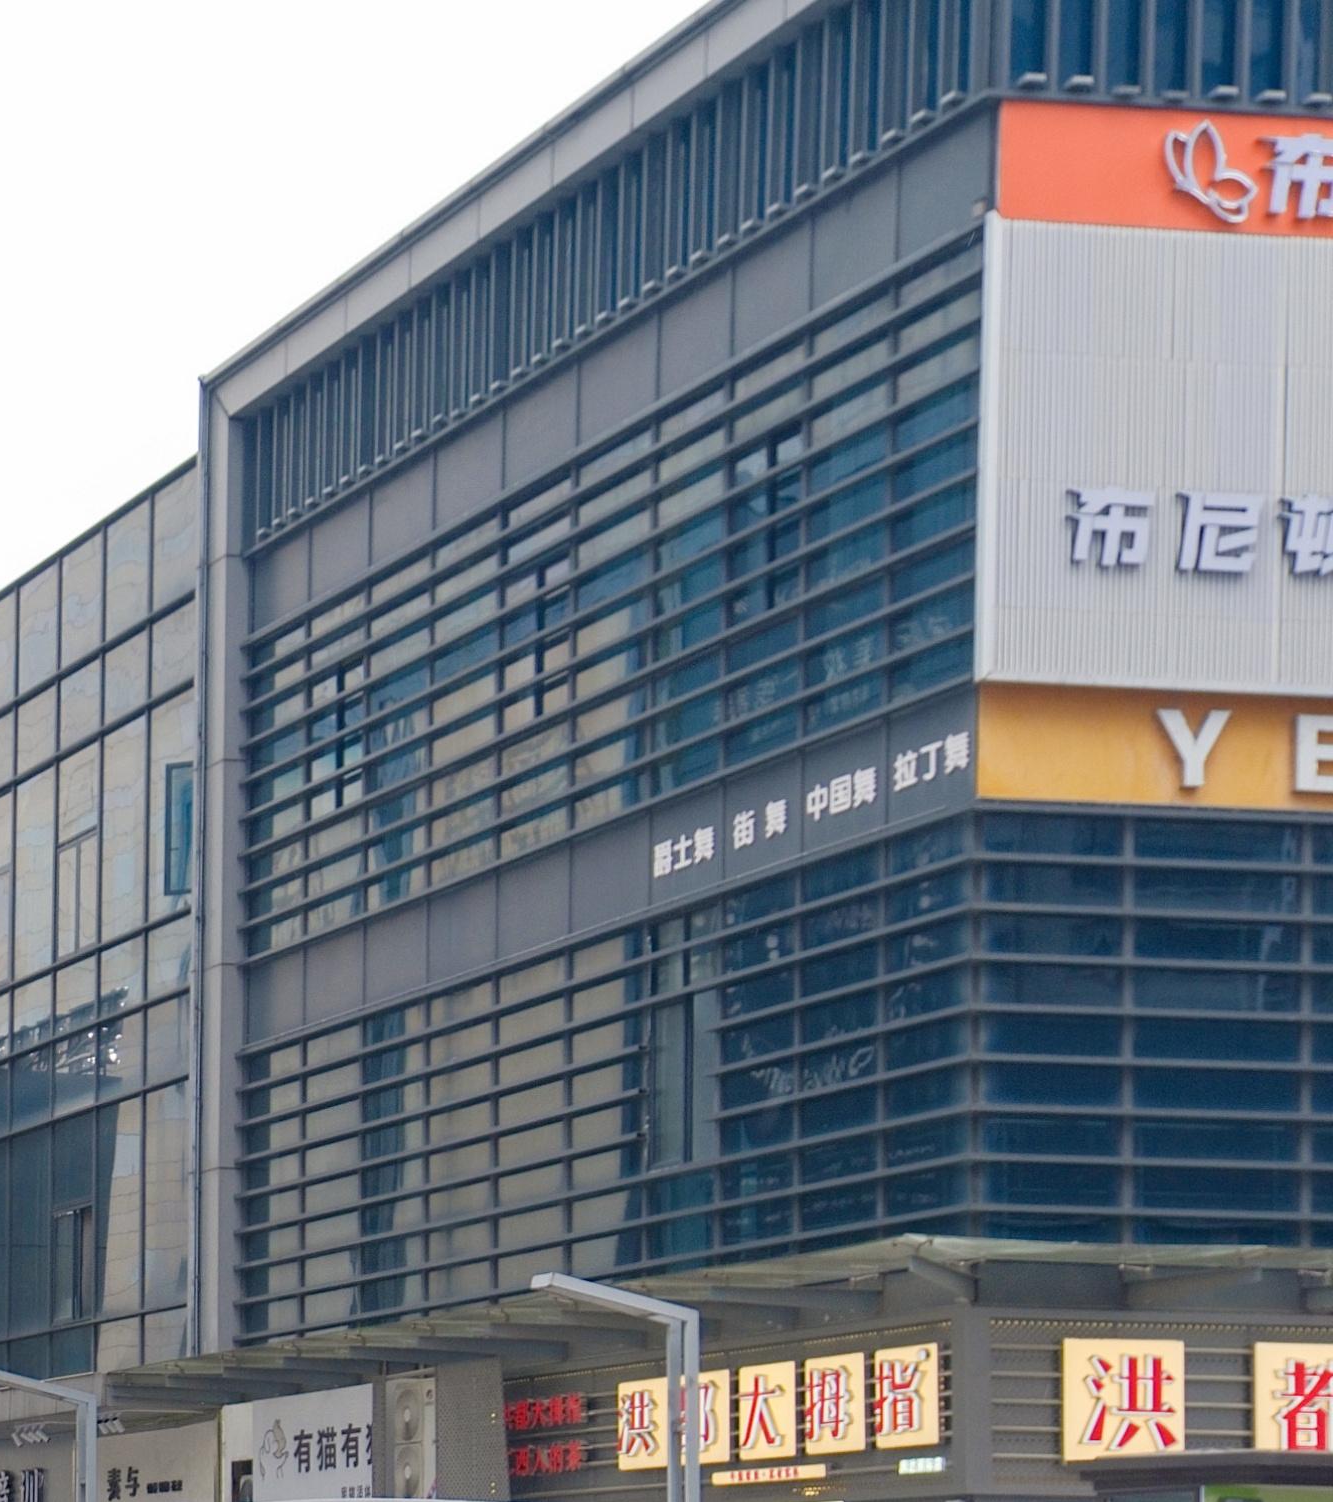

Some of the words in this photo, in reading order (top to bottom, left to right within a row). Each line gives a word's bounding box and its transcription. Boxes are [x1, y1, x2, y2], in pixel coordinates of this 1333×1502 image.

[806, 766, 877, 821] 中国舞
[893, 731, 970, 792] 拉丁舞
